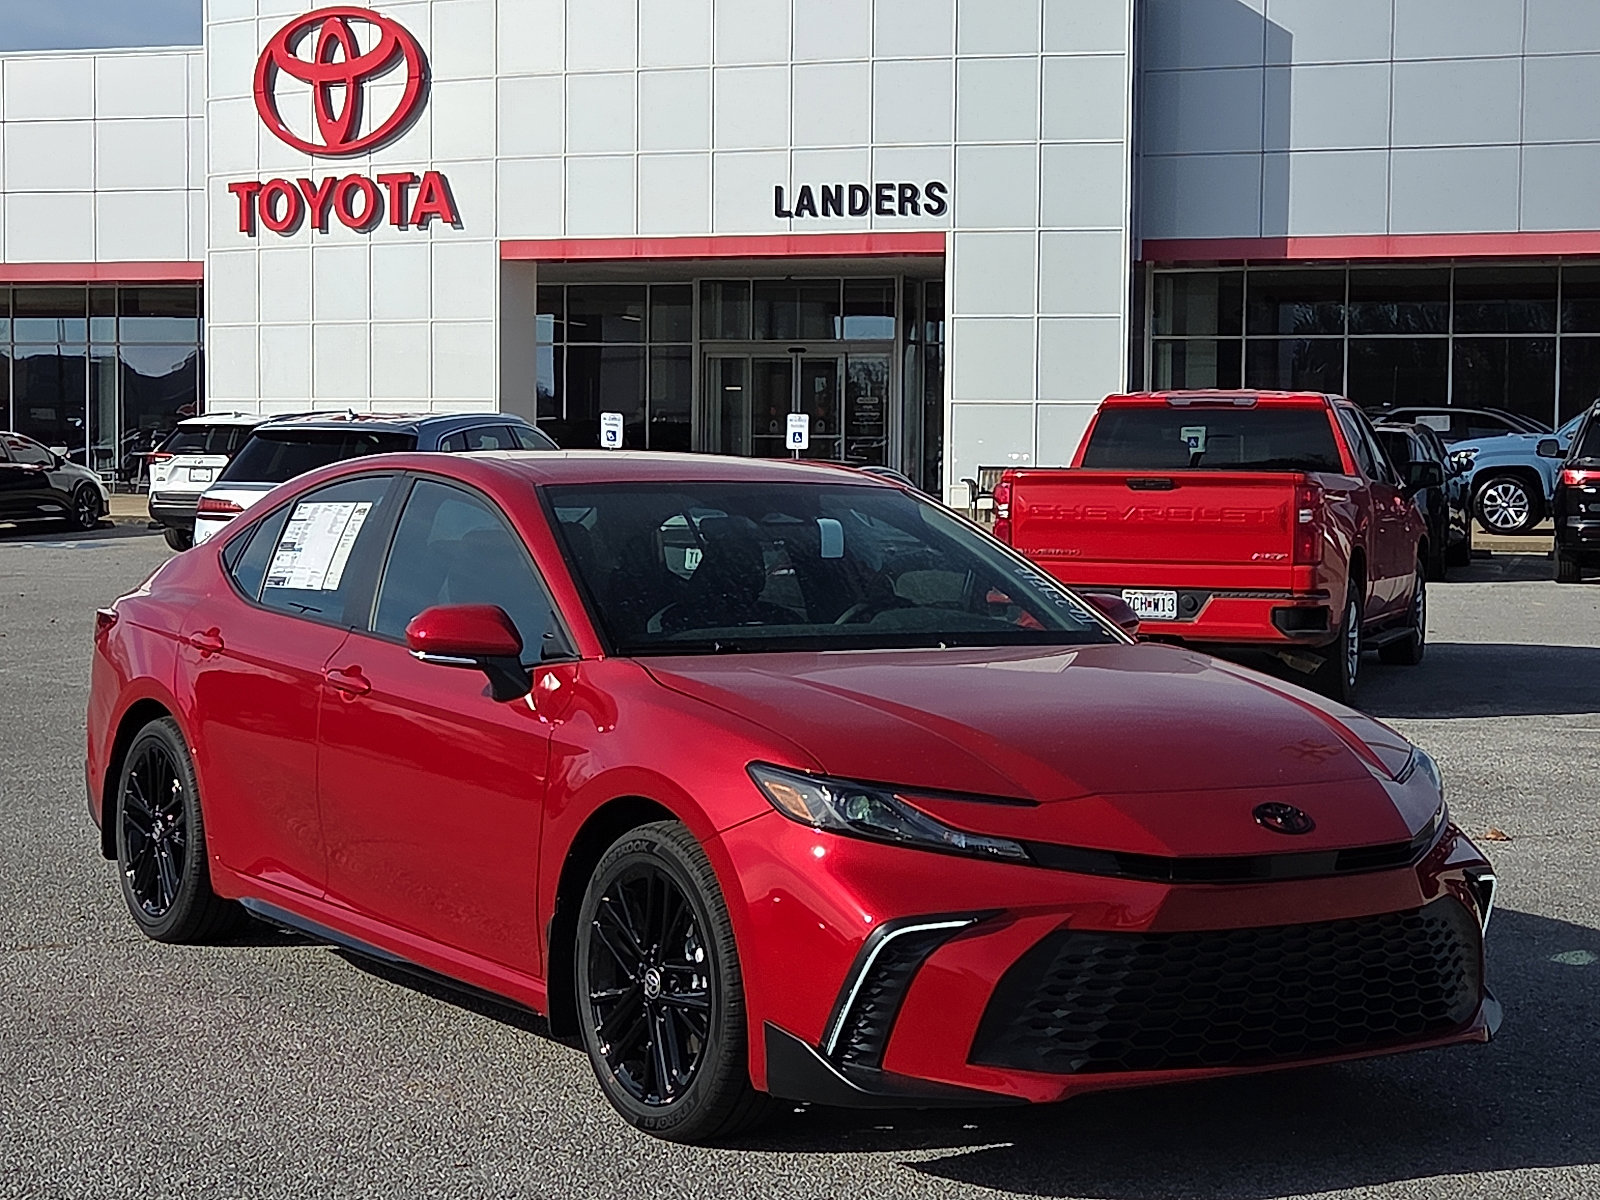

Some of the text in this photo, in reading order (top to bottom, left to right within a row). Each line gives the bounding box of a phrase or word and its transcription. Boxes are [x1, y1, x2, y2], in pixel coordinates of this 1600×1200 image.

[228, 171, 461, 236] TOYOTA
[774, 182, 948, 218] LANDERS
[1028, 504, 1275, 523] CHEVROLET
